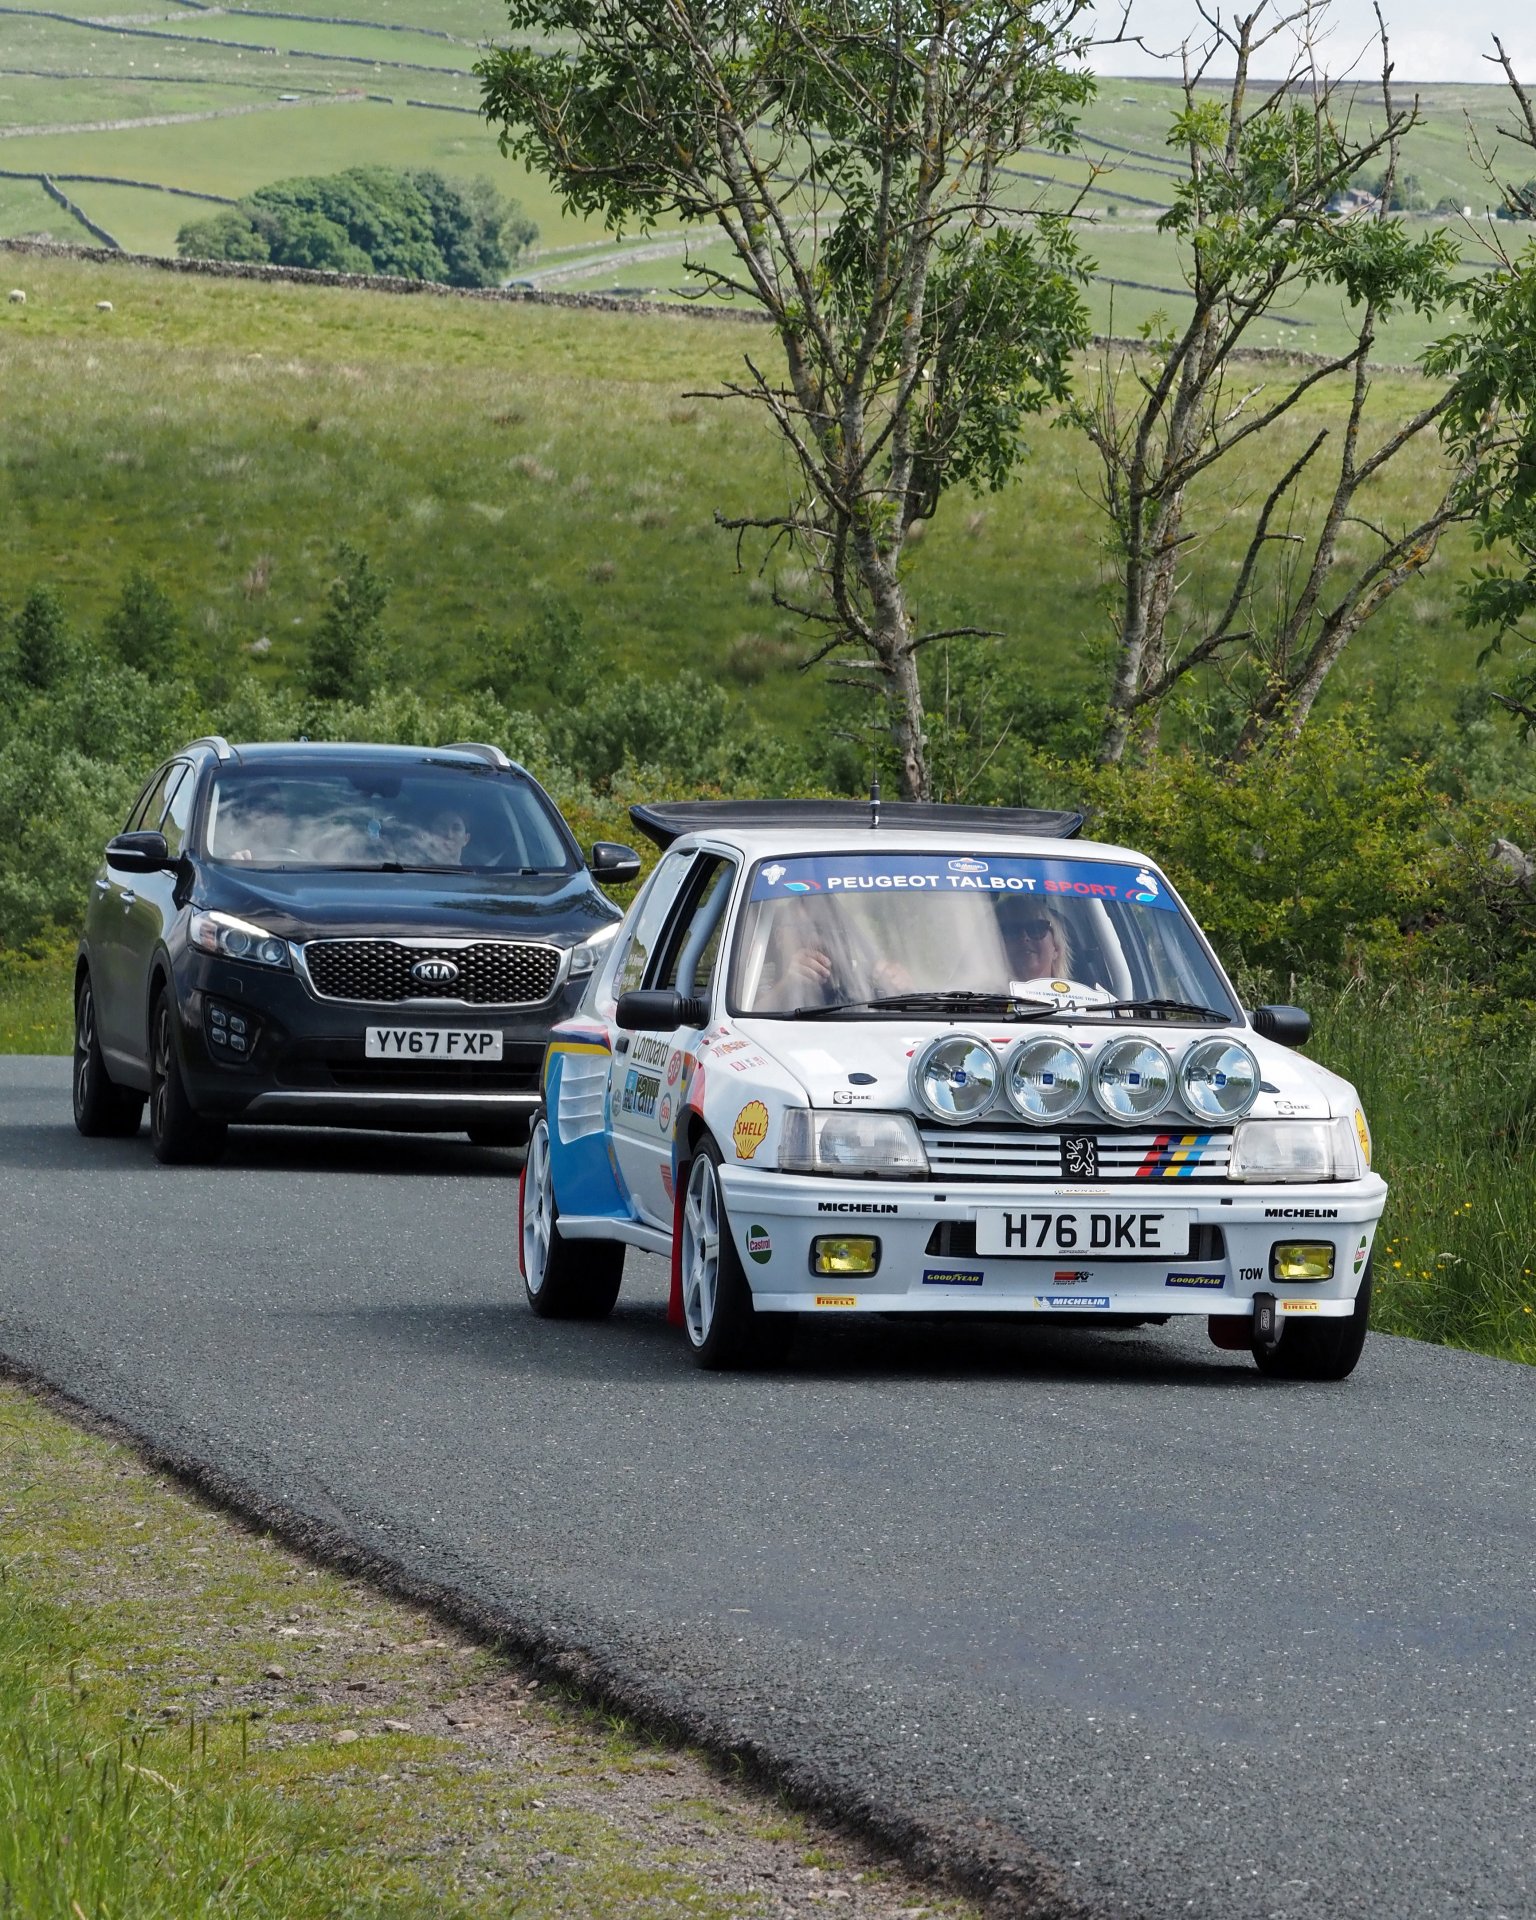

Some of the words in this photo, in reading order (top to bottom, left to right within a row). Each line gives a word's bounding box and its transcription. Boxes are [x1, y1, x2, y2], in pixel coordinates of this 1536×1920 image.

[827, 875, 940, 889] PEUGEOT
[946, 875, 1036, 890] TALBOT
[1044, 880, 1117, 897] SPORT
[420, 965, 450, 979] KIA
[377, 1031, 440, 1053] YY67
[447, 1032, 494, 1054] FXP
[737, 1121, 762, 1136] SHELL
[818, 1202, 898, 1213] MICHELIN
[1265, 1208, 1338, 1218] MICHELIN
[1004, 1213, 1078, 1248] H76
[1090, 1213, 1162, 1248] DKE
[750, 1239, 771, 1251] Castrol
[1239, 1268, 1263, 1281] TOW
[817, 1297, 855, 1305] PIRELLI
[1283, 1302, 1317, 1310] PIRELLI
